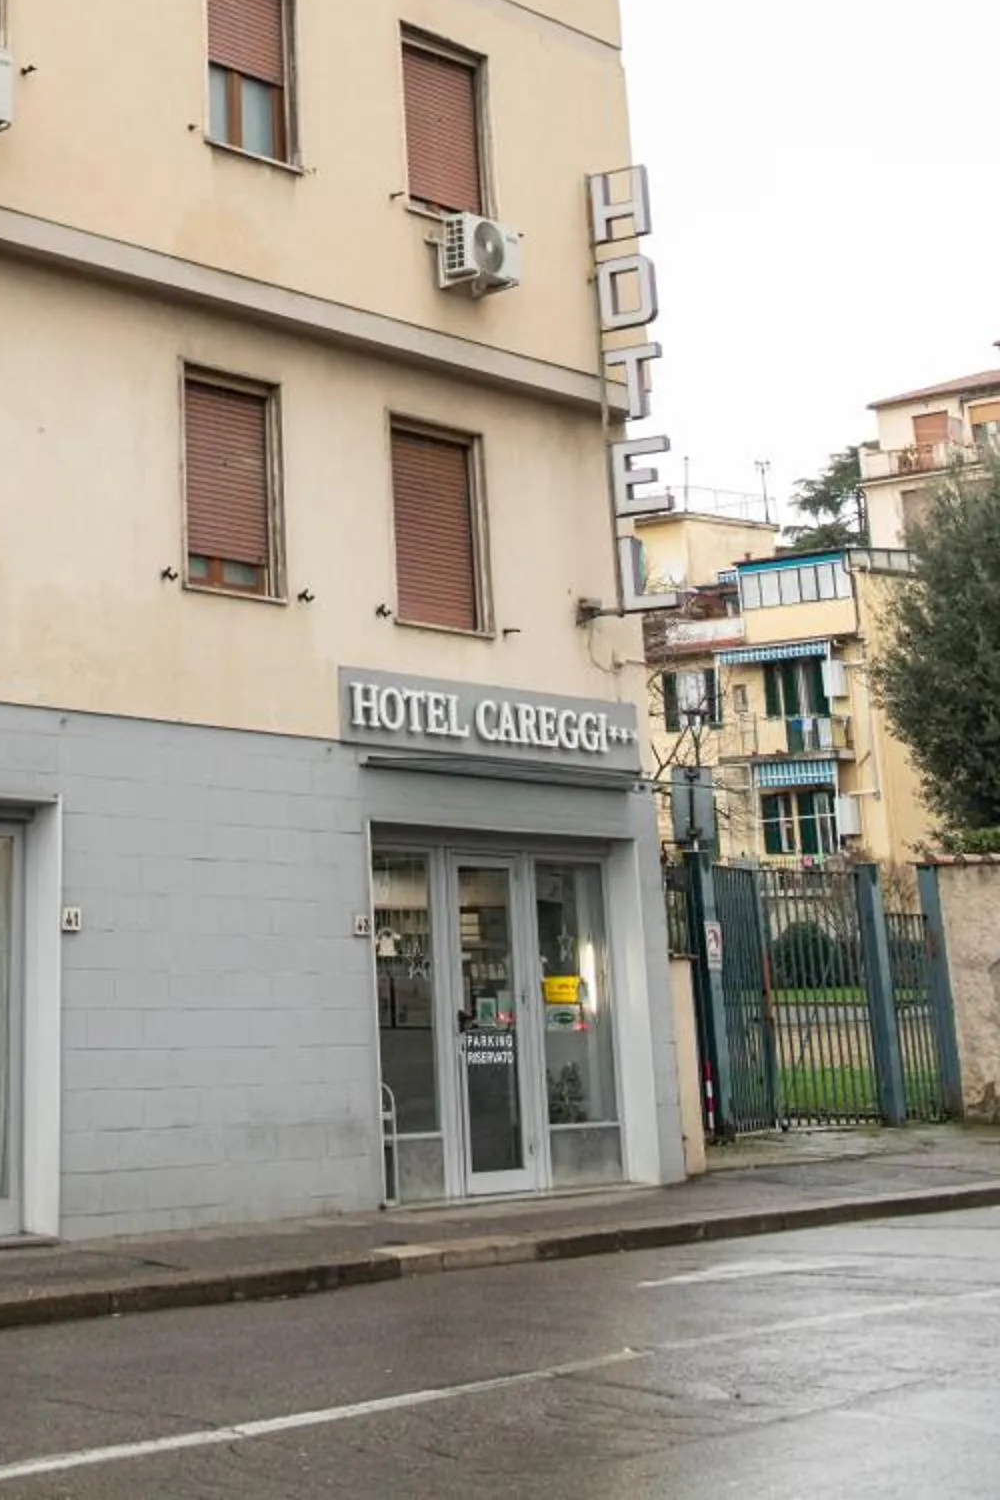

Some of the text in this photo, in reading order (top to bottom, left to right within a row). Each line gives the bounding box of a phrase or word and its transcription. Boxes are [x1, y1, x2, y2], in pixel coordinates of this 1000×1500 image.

[589, 163, 678, 612] HOTEL
[350, 681, 609, 752] HOTEL CAREGGI
[467, 1034, 513, 1047] PARKING
[467, 1051, 514, 1065] RISERVATO
